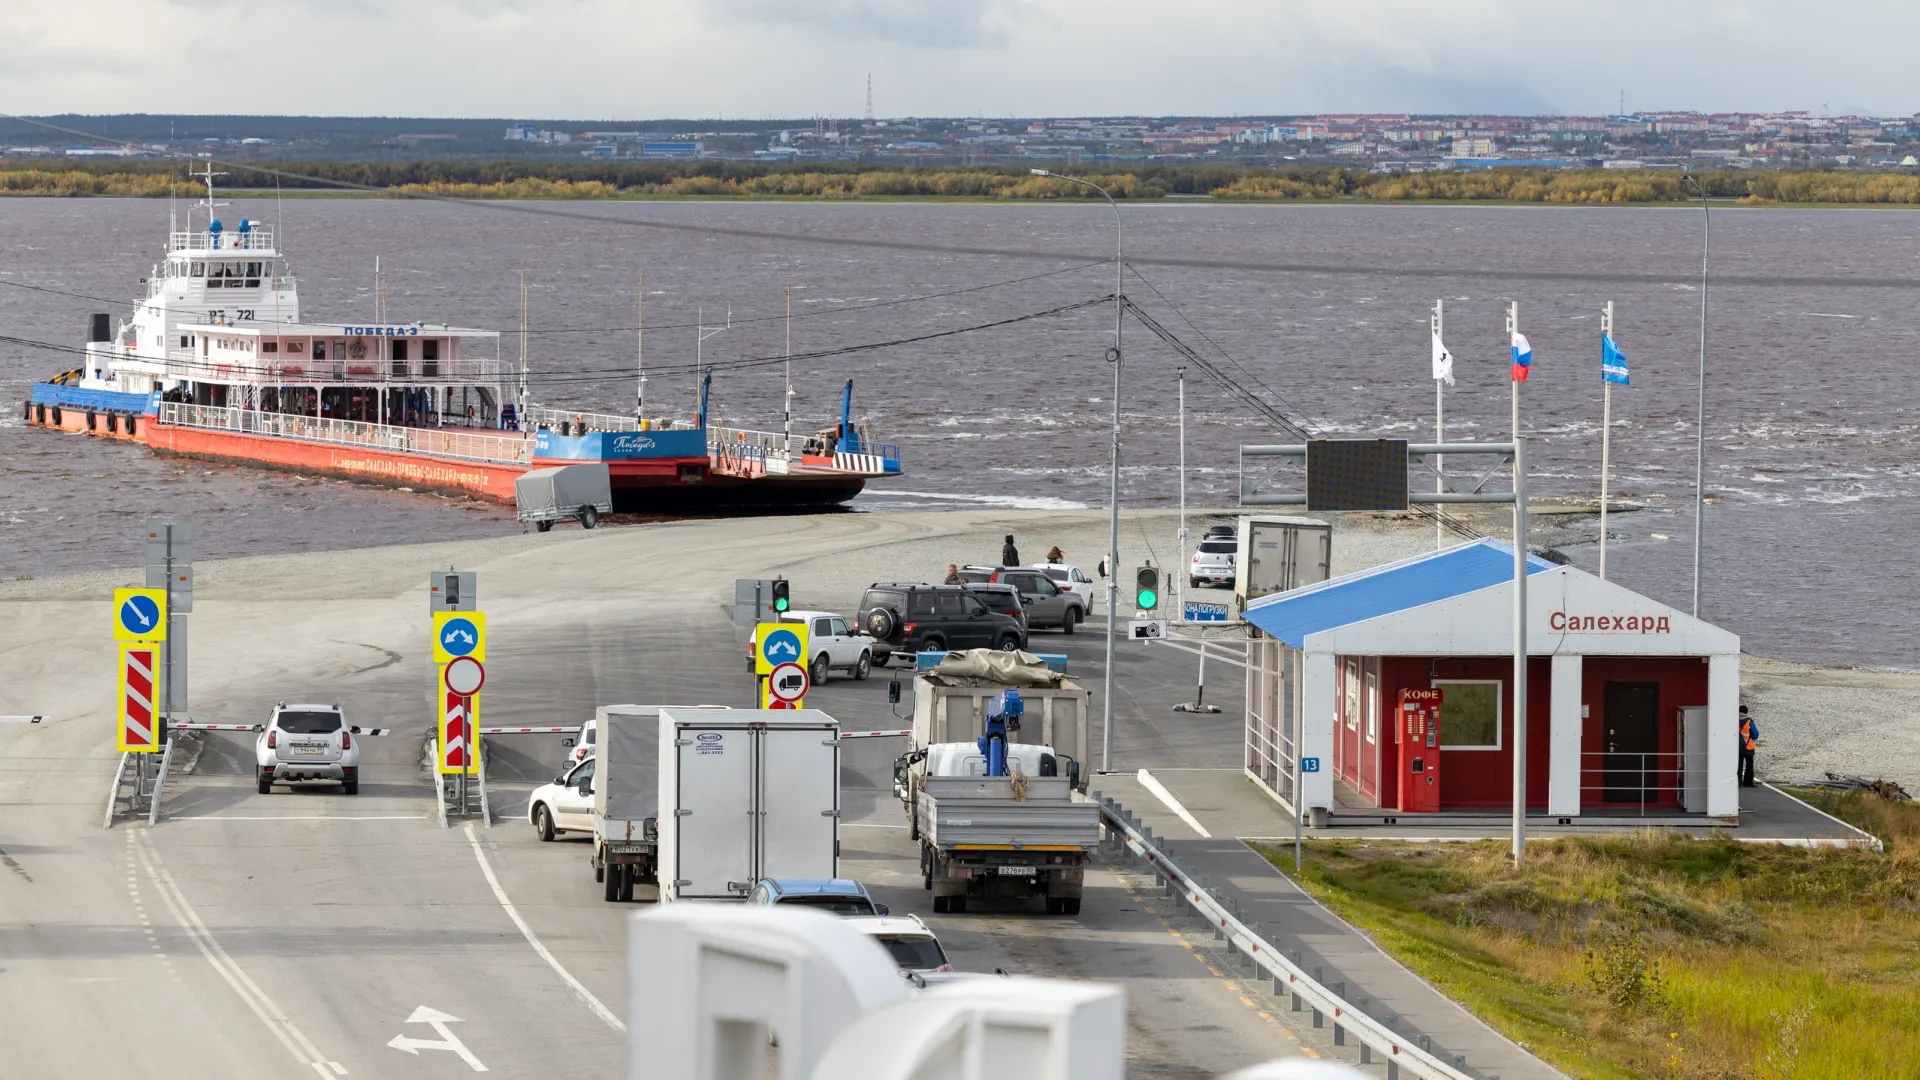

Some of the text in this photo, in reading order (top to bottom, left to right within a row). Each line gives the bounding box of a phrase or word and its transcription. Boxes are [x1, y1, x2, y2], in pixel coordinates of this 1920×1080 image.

[236, 309, 255, 320] 721
[344, 327, 418, 336] ПОБЕДА-3
[1550, 611, 1670, 634] Салехард
[1404, 690, 1438, 699] КОФЕ
[1304, 760, 1317, 770] 13
